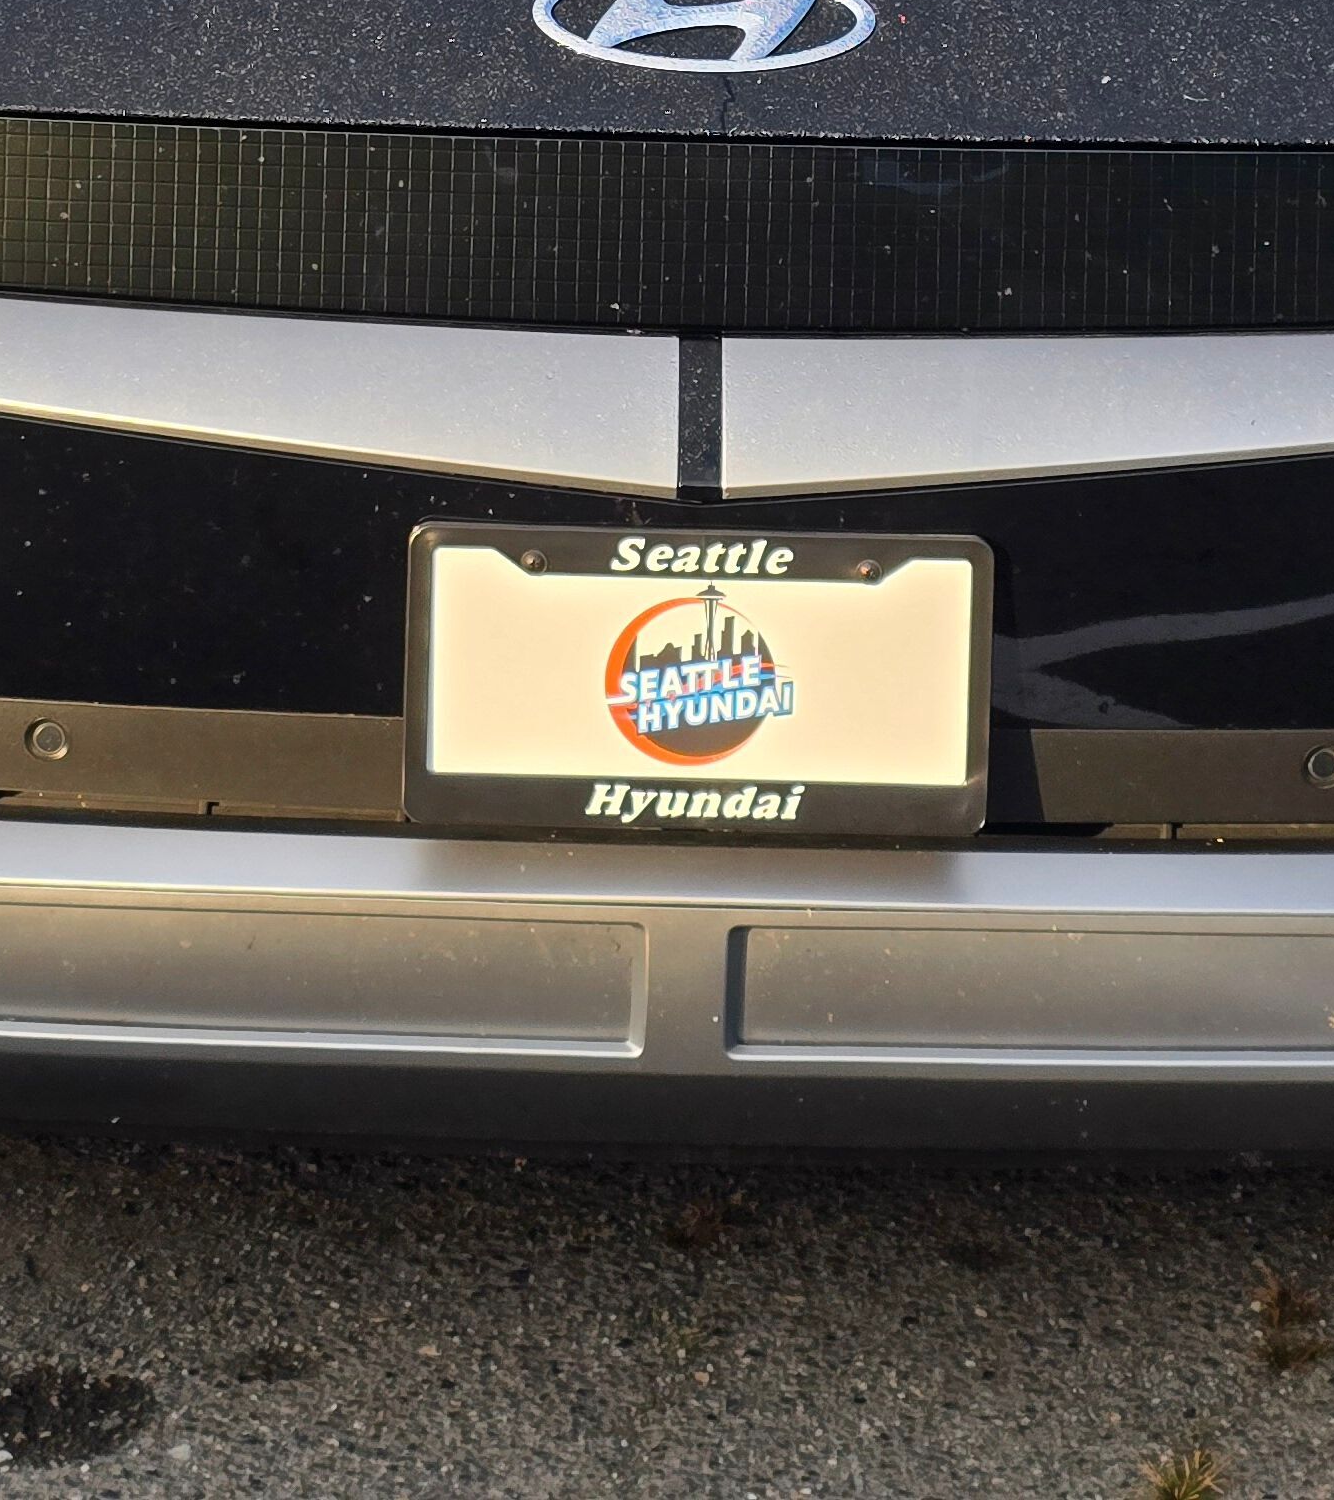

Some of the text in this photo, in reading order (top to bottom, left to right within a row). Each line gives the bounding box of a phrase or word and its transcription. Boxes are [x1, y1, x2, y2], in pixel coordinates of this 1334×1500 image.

[611, 537, 794, 575] Seattle
[620, 656, 762, 701] SEATTLE
[637, 681, 794, 734] HYUNDAI
[585, 784, 805, 823] Hyundai
